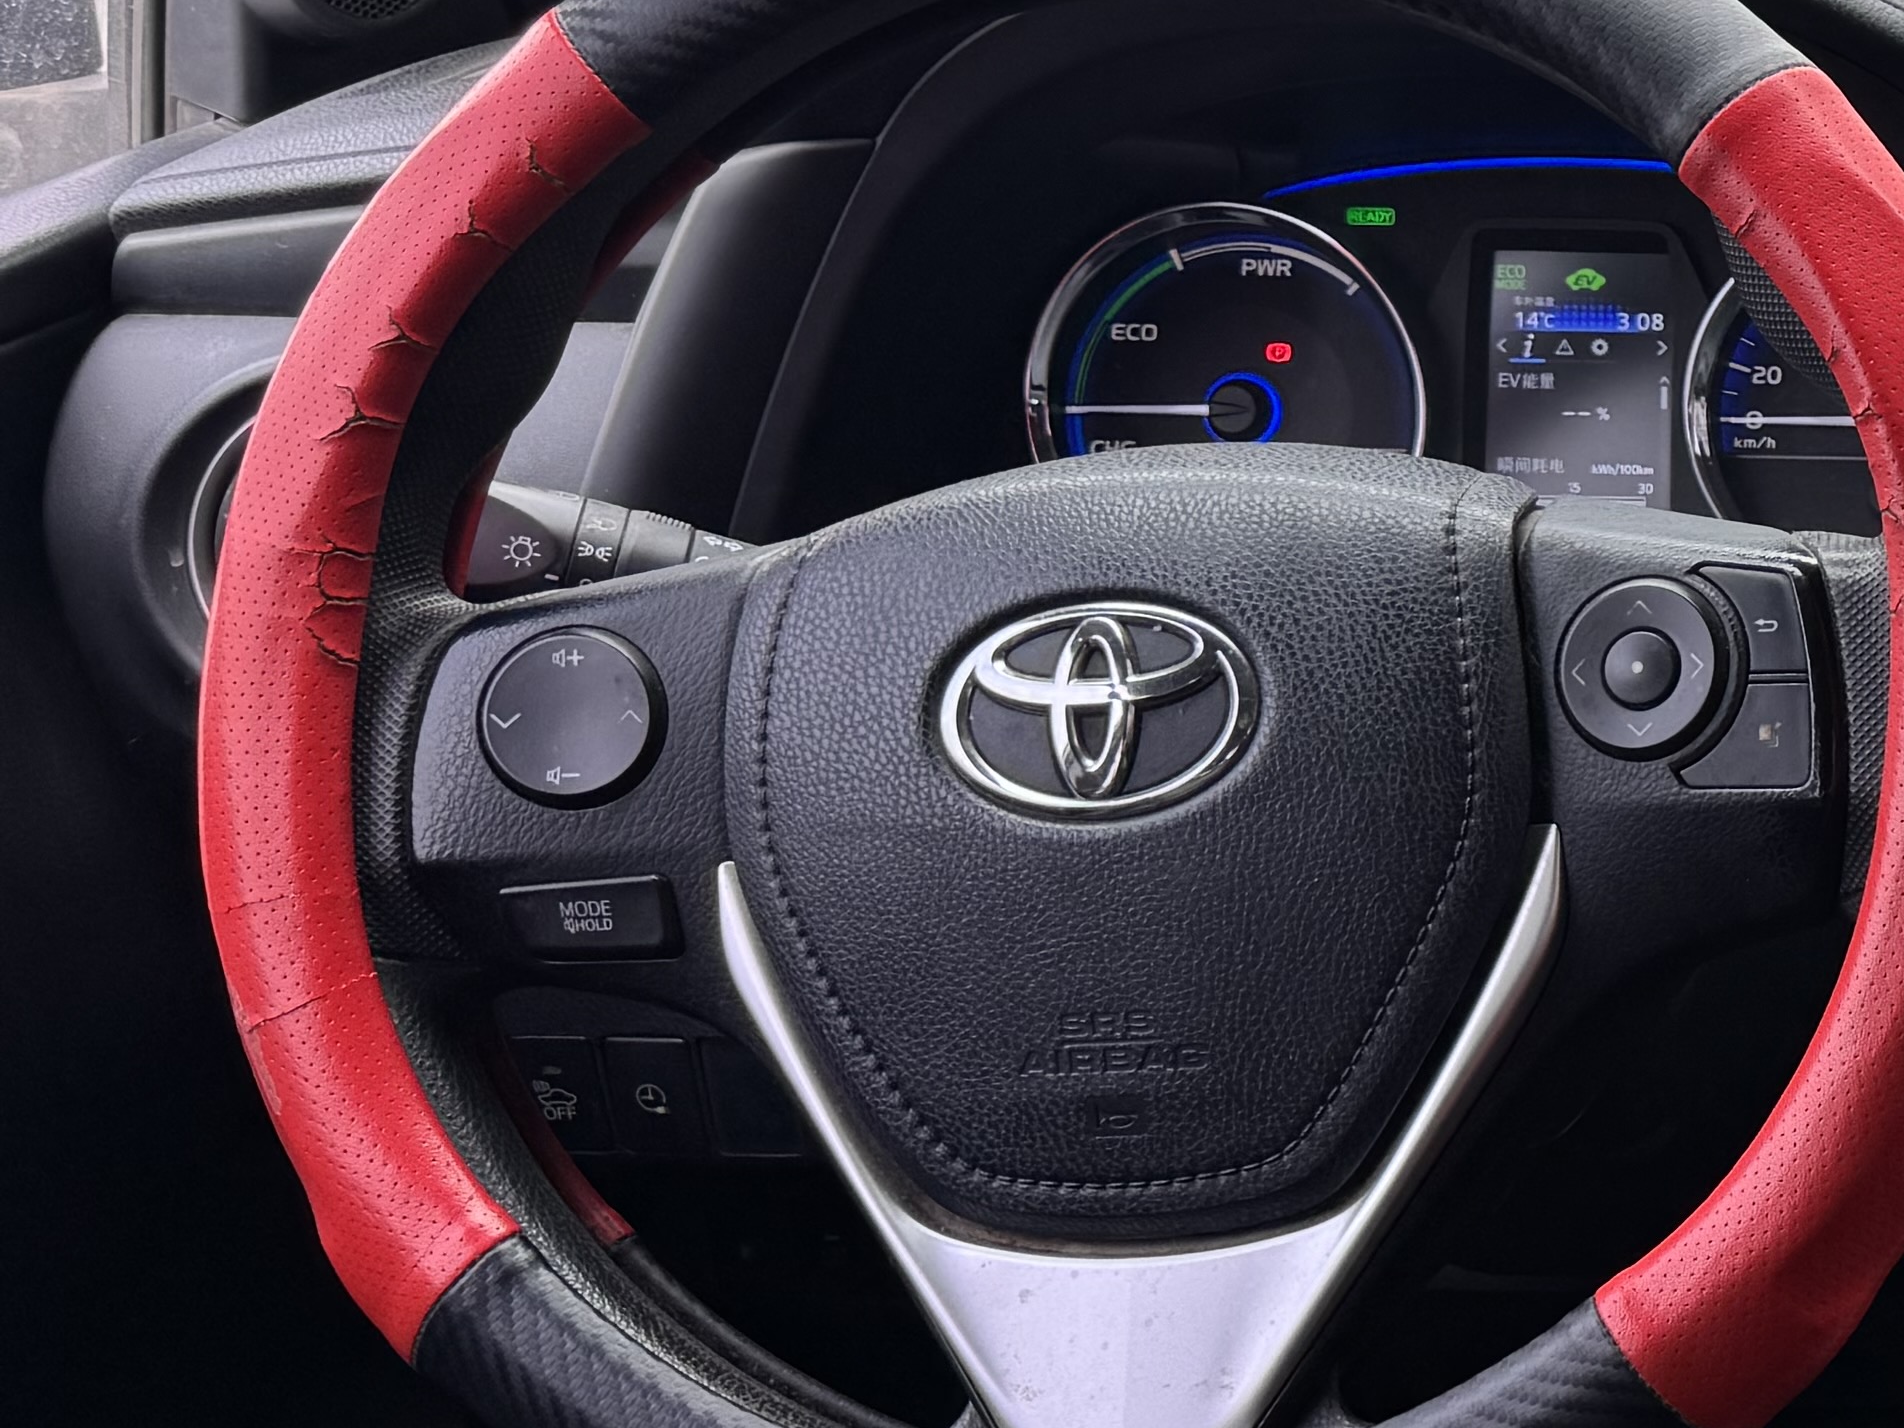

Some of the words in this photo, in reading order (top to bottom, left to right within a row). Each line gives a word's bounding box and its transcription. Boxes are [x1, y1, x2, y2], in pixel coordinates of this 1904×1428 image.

[1240, 258, 1293, 277] PWR
[1496, 264, 1526, 278] ECO
[1573, 275, 1597, 287] EV
[1110, 323, 1158, 341] ECO
[1752, 365, 1783, 385] 20
[1733, 435, 1777, 450] km/h
[1637, 484, 1654, 495] 30
[559, 900, 613, 918] MODE
[575, 918, 613, 932] HOLD
[543, 1106, 577, 1121] OFF
